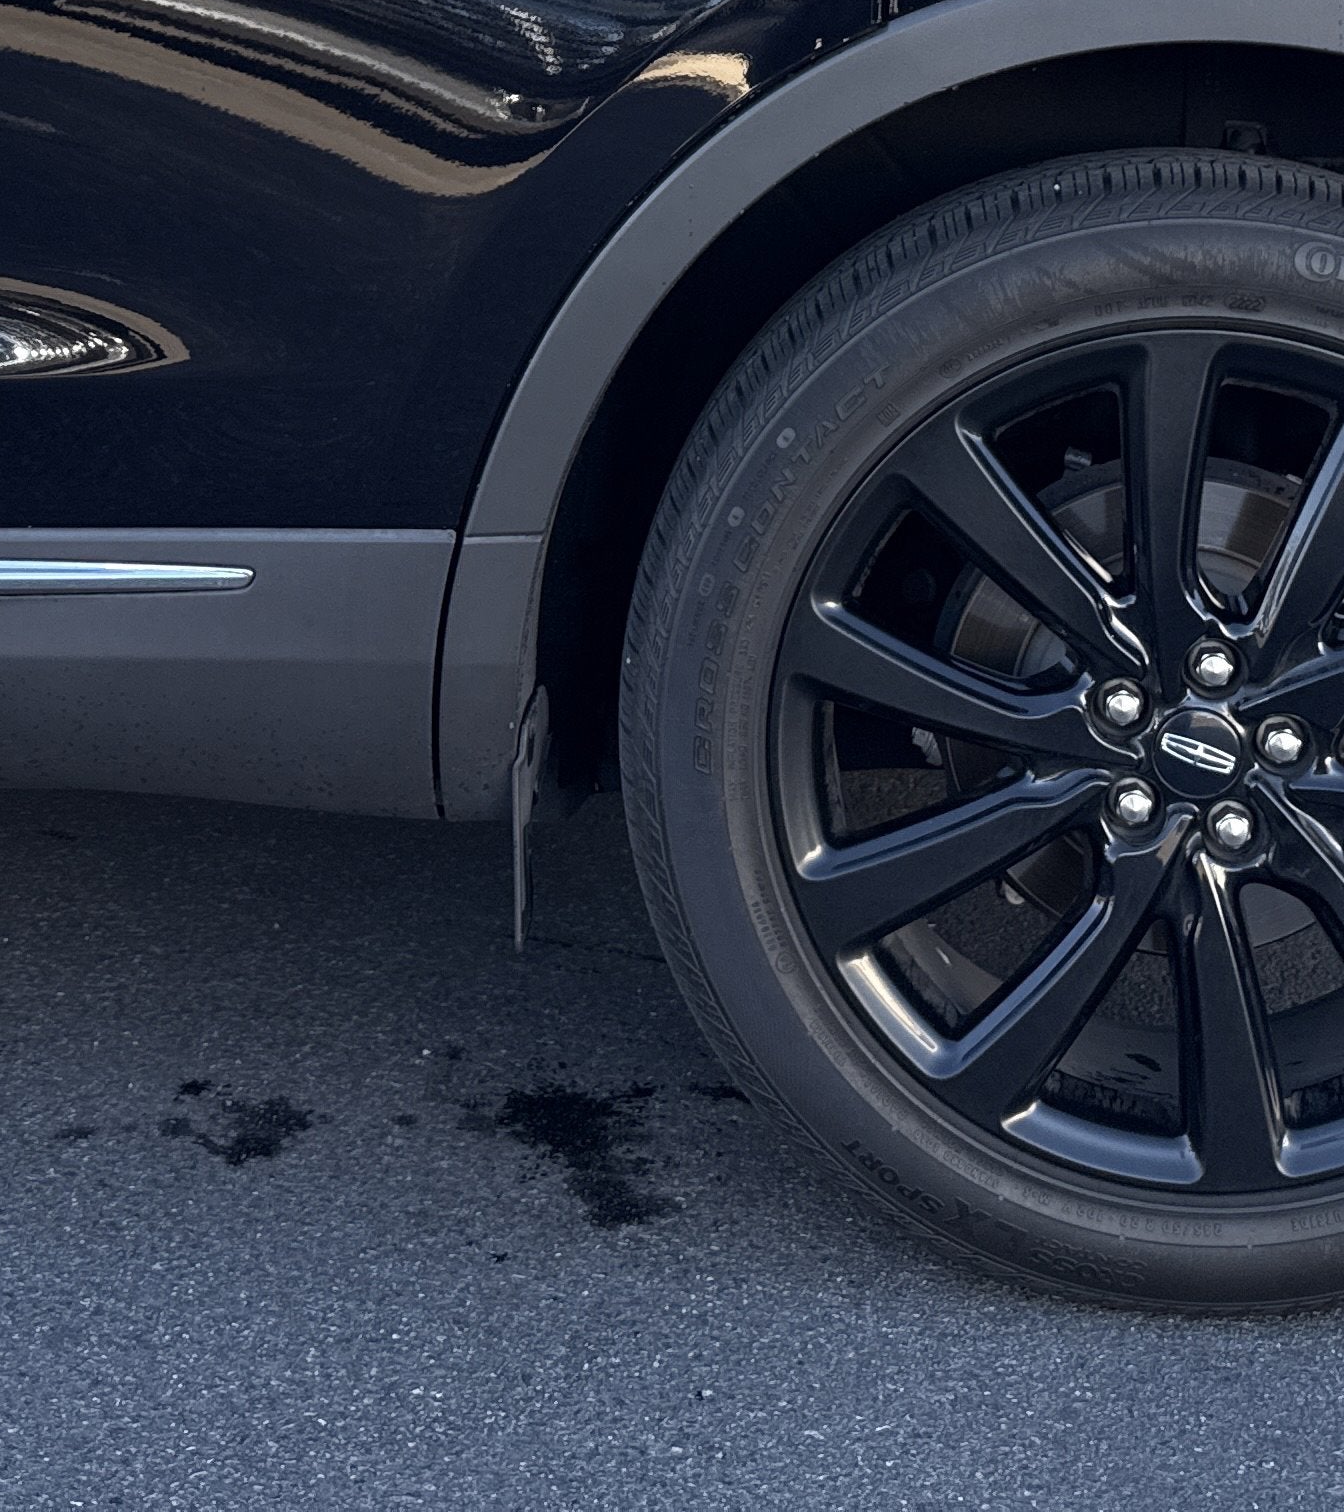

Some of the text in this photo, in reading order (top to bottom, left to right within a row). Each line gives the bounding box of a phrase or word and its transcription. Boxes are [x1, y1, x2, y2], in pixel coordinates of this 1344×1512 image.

[693, 580, 740, 776] CROSS
[733, 363, 896, 574] CONTACT
[839, 1138, 946, 1214] SPORT
